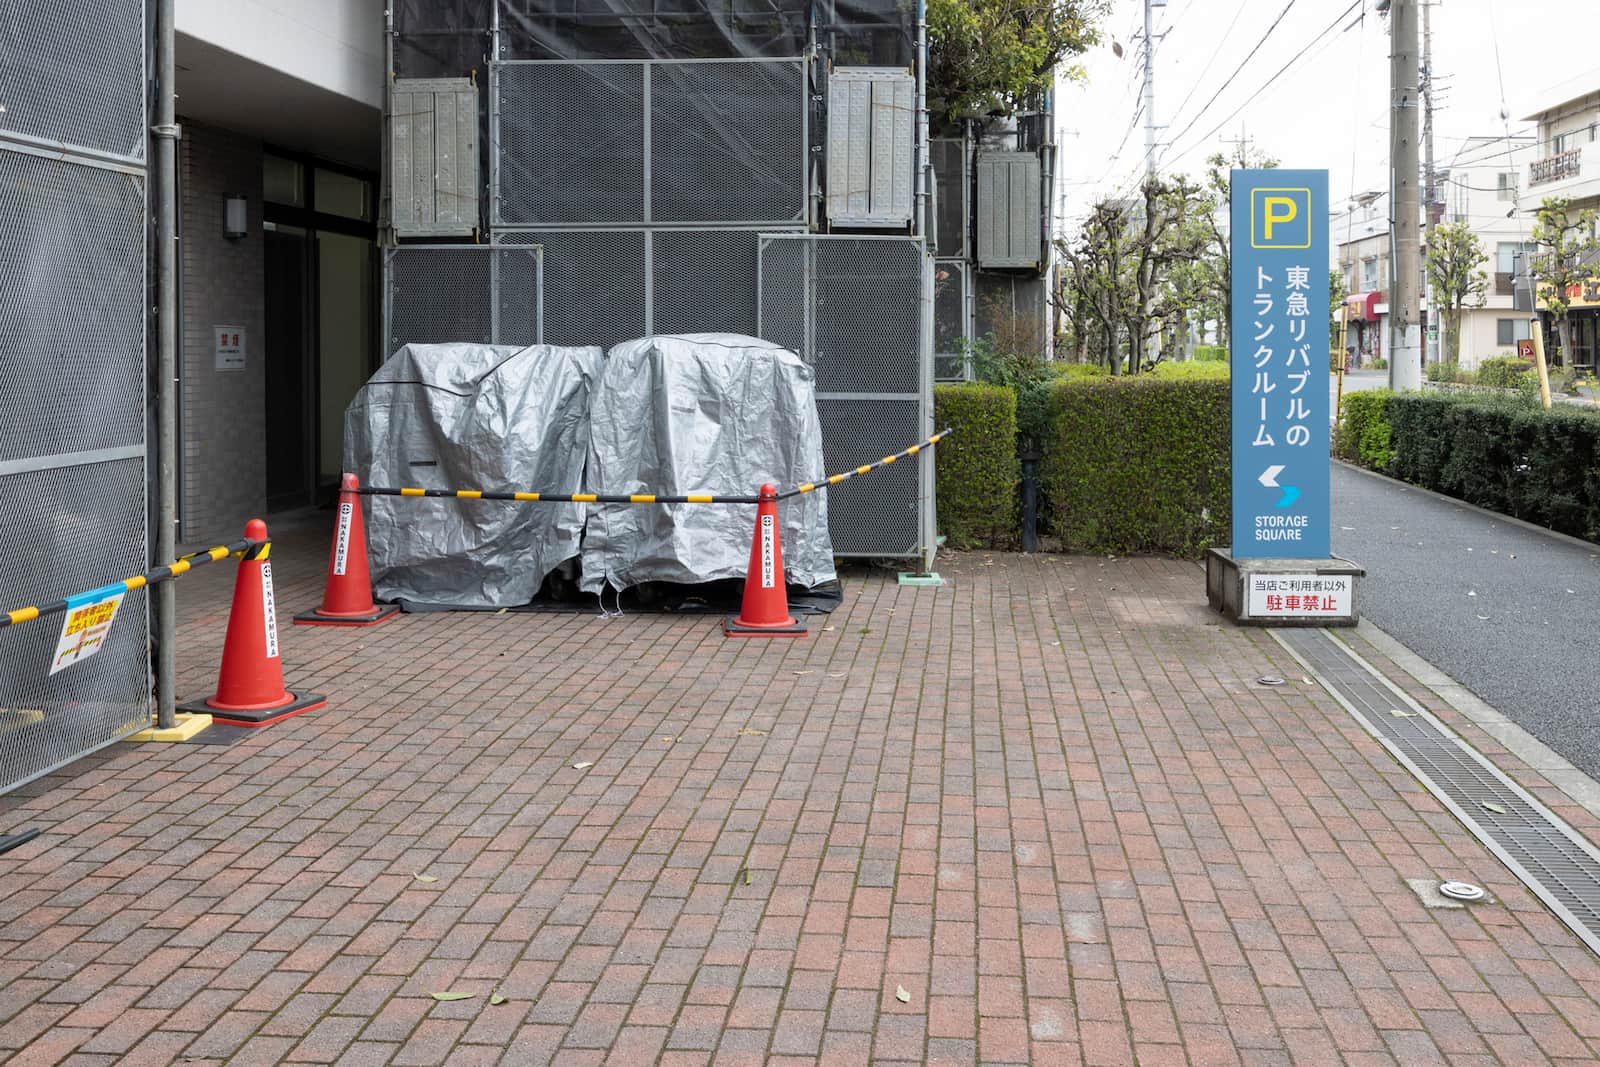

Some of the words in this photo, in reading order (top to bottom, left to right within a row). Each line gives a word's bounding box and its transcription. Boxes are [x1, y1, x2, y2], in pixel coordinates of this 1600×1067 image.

[1264, 197, 1298, 240] P
[1252, 266, 1277, 446] トランクルーム
[1285, 265, 1311, 446] 東急リバブルの
[1255, 515, 1309, 528] STORAGE
[1255, 528, 1303, 541] SQUARE
[337, 524, 347, 574] NAKAMURA
[1255, 580, 1346, 592] 当店ご利用者以外
[1266, 594, 1338, 611] 駐車禁止
[267, 591, 276, 656] NAKAMURA
